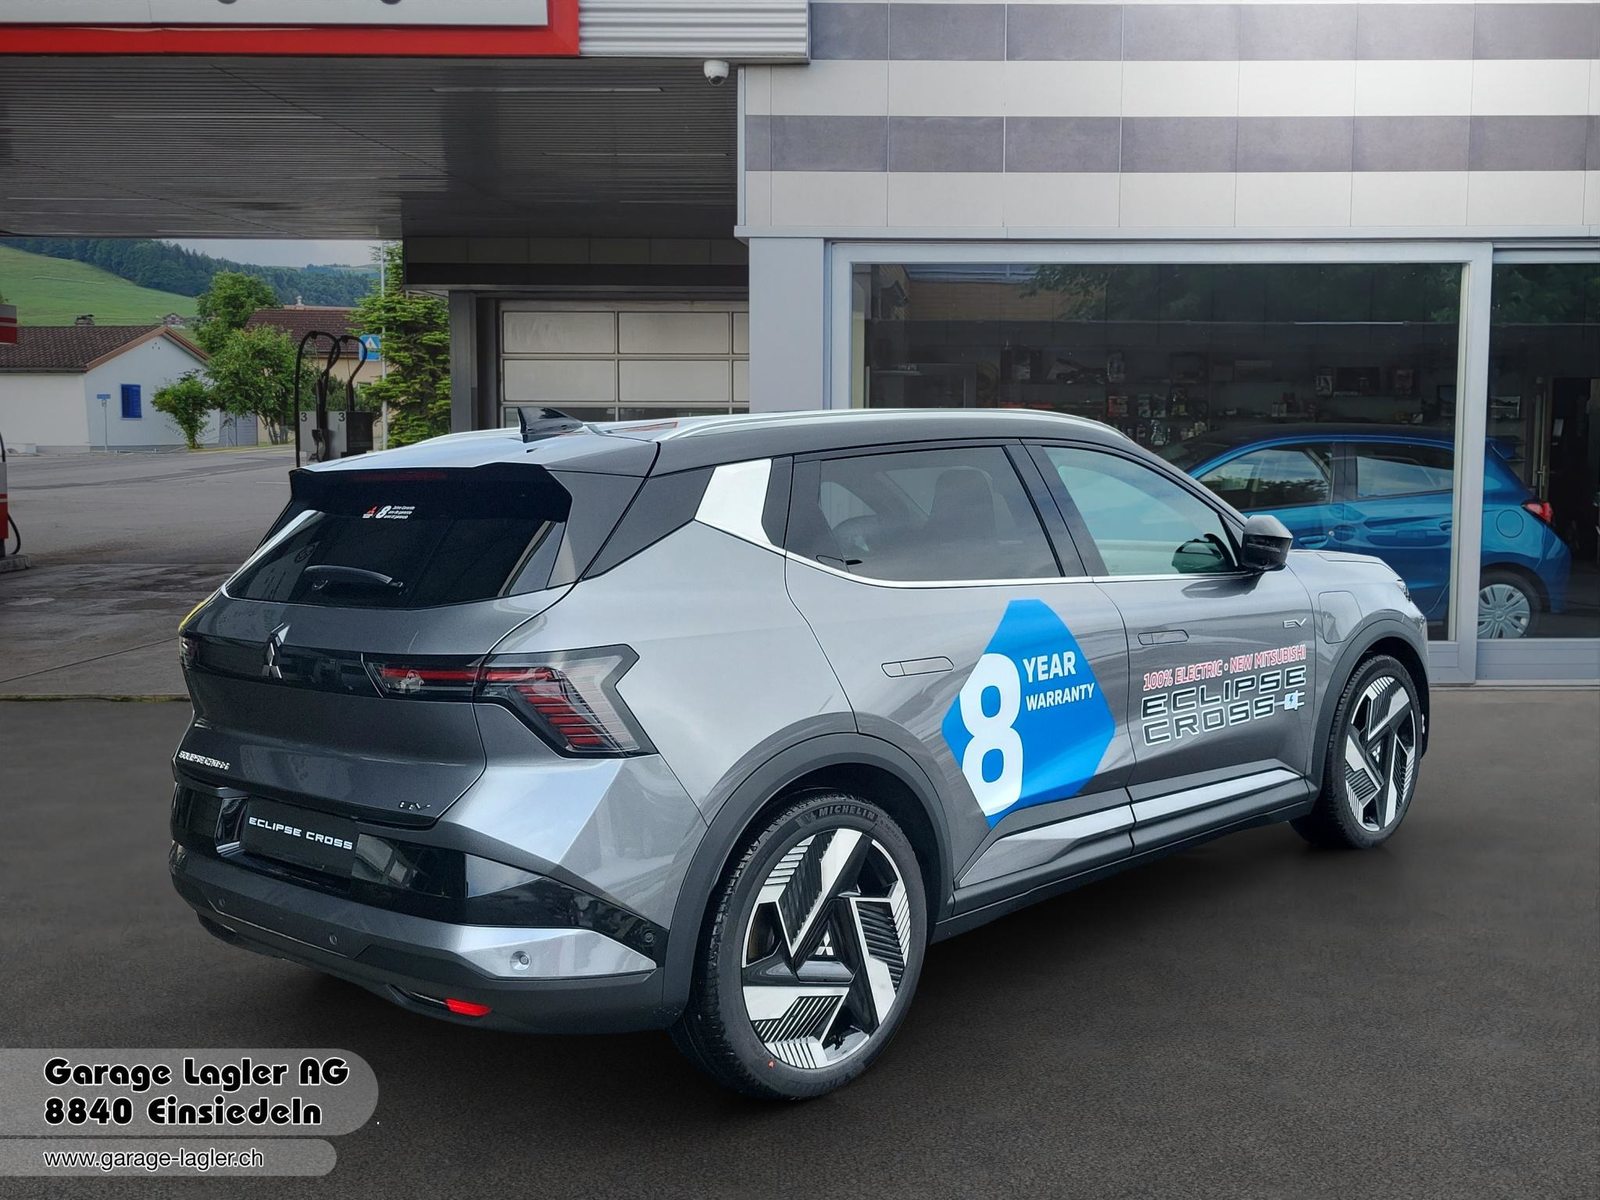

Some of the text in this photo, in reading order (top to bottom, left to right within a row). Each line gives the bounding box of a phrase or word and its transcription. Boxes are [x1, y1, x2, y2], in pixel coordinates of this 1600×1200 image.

[301, 412, 308, 422] 3
[338, 412, 345, 422] 3
[375, 506, 391, 518] 8
[1283, 618, 1307, 628] EV
[1022, 650, 1076, 683] YEAR
[1143, 644, 1307, 691] 100% ELECTRIC NEW MITSUBISHI
[1025, 682, 1095, 712] WARRANTY
[1141, 664, 1307, 720] ECLIPSE
[959, 653, 1023, 817] 8
[1143, 694, 1276, 746] CROSS
[818, 804, 876, 821] MICHELIN
[248, 816, 353, 851] ECLIPSE CROSS
